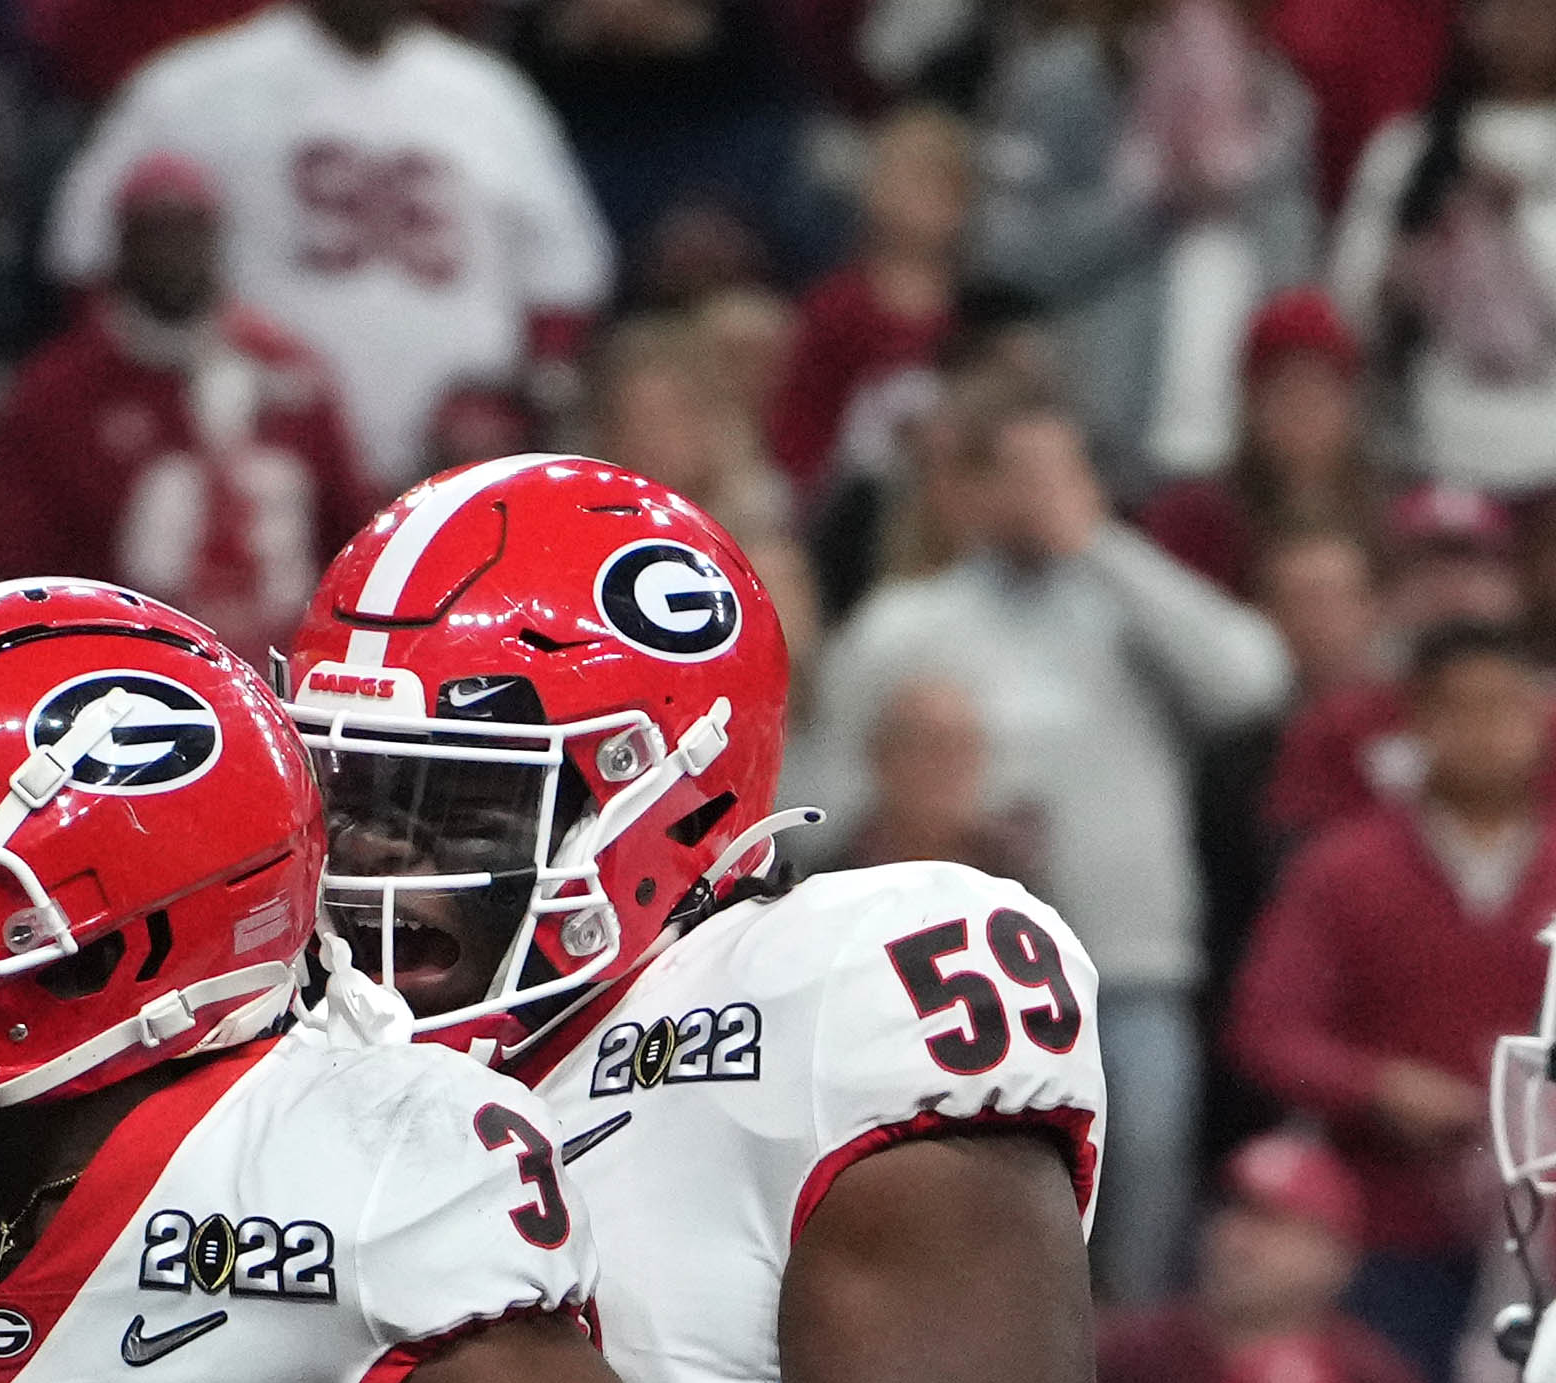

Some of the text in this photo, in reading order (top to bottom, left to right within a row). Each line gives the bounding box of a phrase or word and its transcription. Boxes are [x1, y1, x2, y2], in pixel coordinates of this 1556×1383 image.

[597, 541, 739, 659] G
[590, 1002, 761, 1099] 2022
[885, 907, 1082, 1077] 59
[473, 1102, 570, 1250] 3
[138, 1210, 337, 1303] 2022
